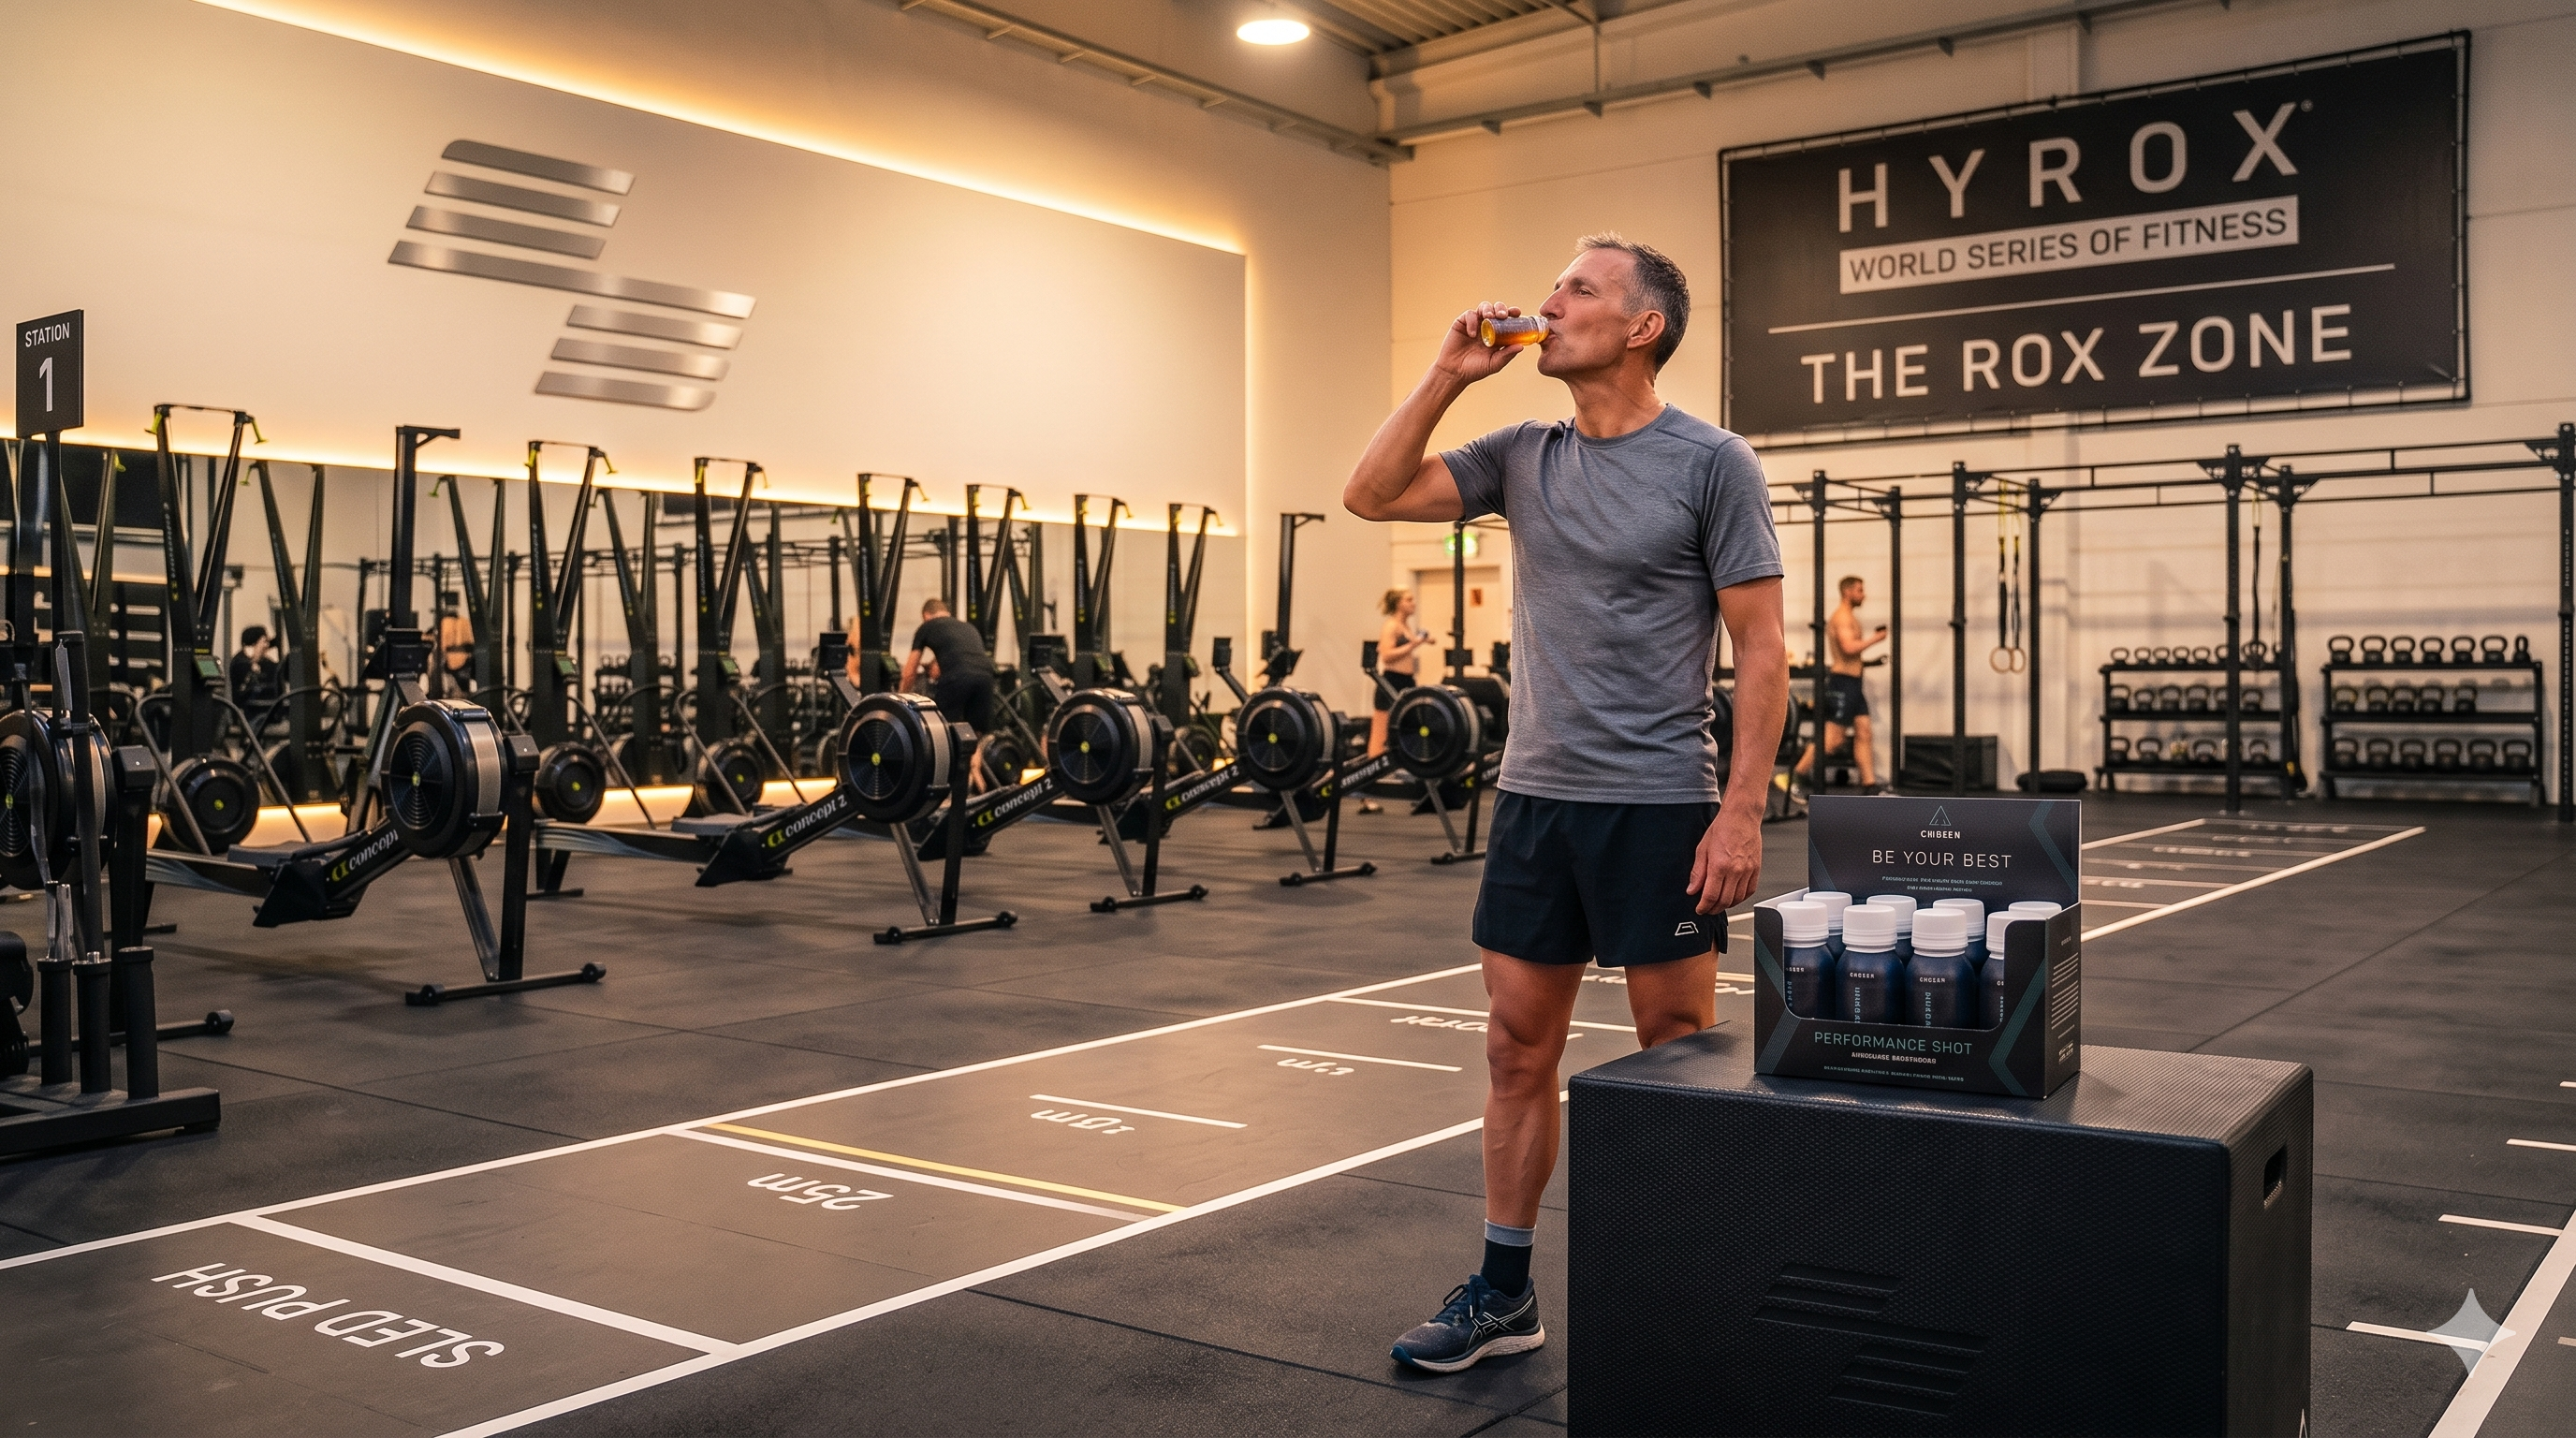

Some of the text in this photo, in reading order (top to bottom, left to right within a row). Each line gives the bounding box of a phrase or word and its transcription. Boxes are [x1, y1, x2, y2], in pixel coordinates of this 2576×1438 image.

[1838, 101, 2299, 233] HYROX
[1850, 208, 2288, 283] WORLD SERIES OF FITNESS
[25, 322, 70, 347] STATION
[1800, 303, 2352, 404] THE ROX ZONE
[38, 357, 53, 412] 1
[1044, 778, 1053, 790] 2
[1872, 849, 2012, 868] BE YOUR BEST
[1814, 1032, 1972, 1055] PERFORMANCE SHOT
[747, 1172, 895, 1211] 25m
[151, 1262, 505, 1369] SLED PUSH
